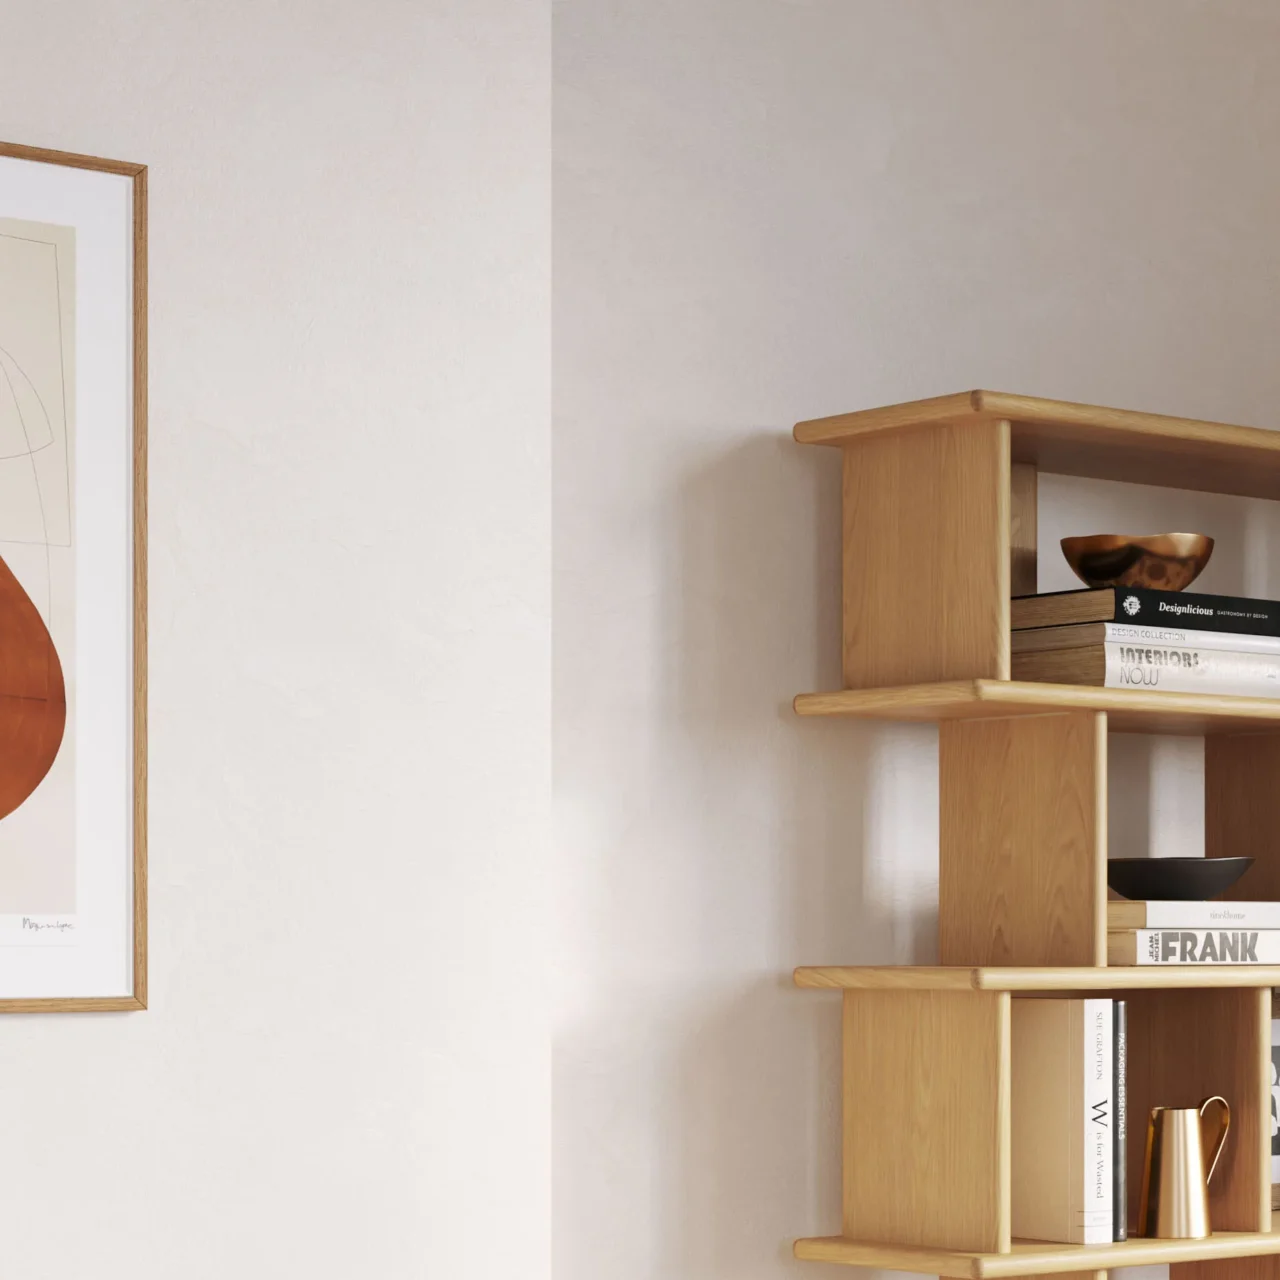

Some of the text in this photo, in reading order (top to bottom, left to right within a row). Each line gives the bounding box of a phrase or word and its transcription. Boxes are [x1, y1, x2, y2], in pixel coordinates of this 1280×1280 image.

[1159, 602, 1214, 616] Designlicious
[1112, 628, 1186, 641] DESIGN COLLECTION
[1119, 647, 1199, 668] INTERIORS
[1119, 667, 1159, 686] NOW
[1161, 931, 1259, 962] FRANK
[1118, 1032, 1126, 1141] PACKAGING ESSENTIALS
[1092, 1098, 1108, 1199] W is for Wasted
